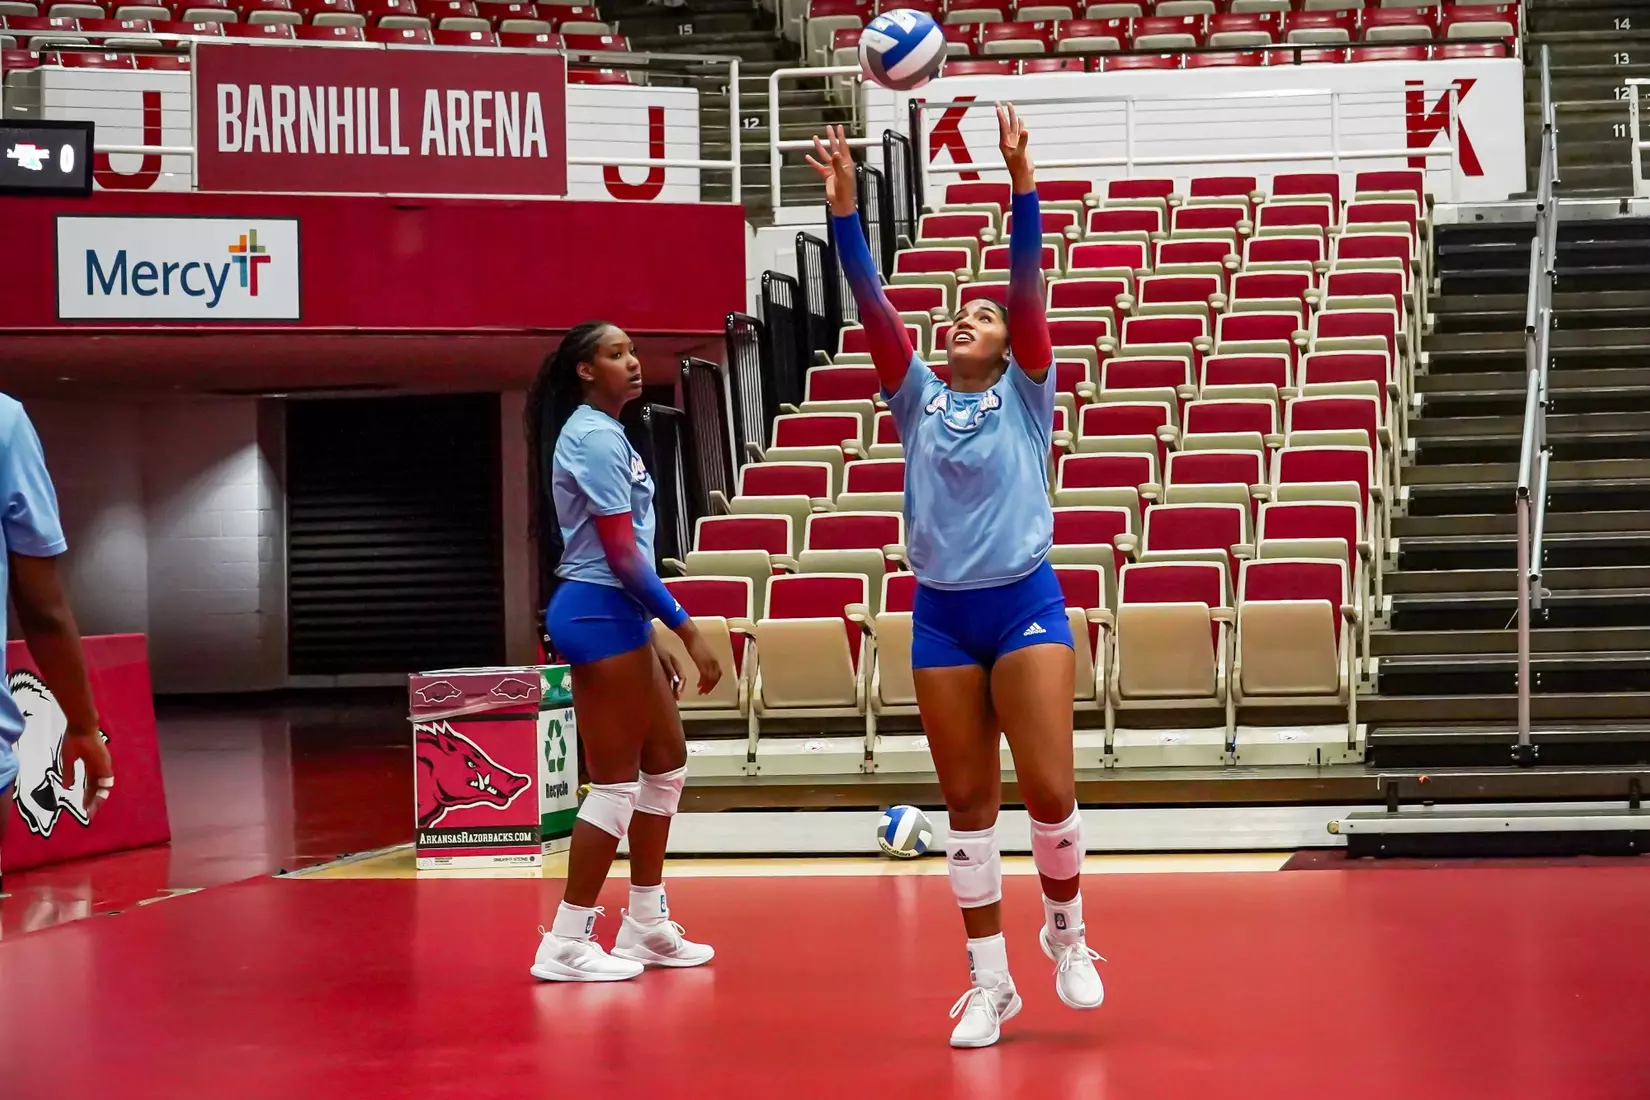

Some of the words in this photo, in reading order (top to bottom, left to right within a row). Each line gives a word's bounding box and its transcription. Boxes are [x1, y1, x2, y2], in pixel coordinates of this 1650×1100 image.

[678, 24, 693, 35] 15
[1613, 18, 1631, 30] 14
[1613, 53, 1630, 65] 13
[1613, 87, 1631, 100] 12
[217, 83, 410, 155] BARNHILL
[421, 89, 548, 158] ARENA
[743, 118, 759, 128] 12
[1405, 78, 1484, 176] K
[93, 91, 162, 189] J
[1612, 124, 1626, 137] 11
[60, 144, 74, 173] 0
[603, 106, 665, 200] J
[86, 249, 231, 308] Mercy
[546, 780, 569, 799] Recycle
